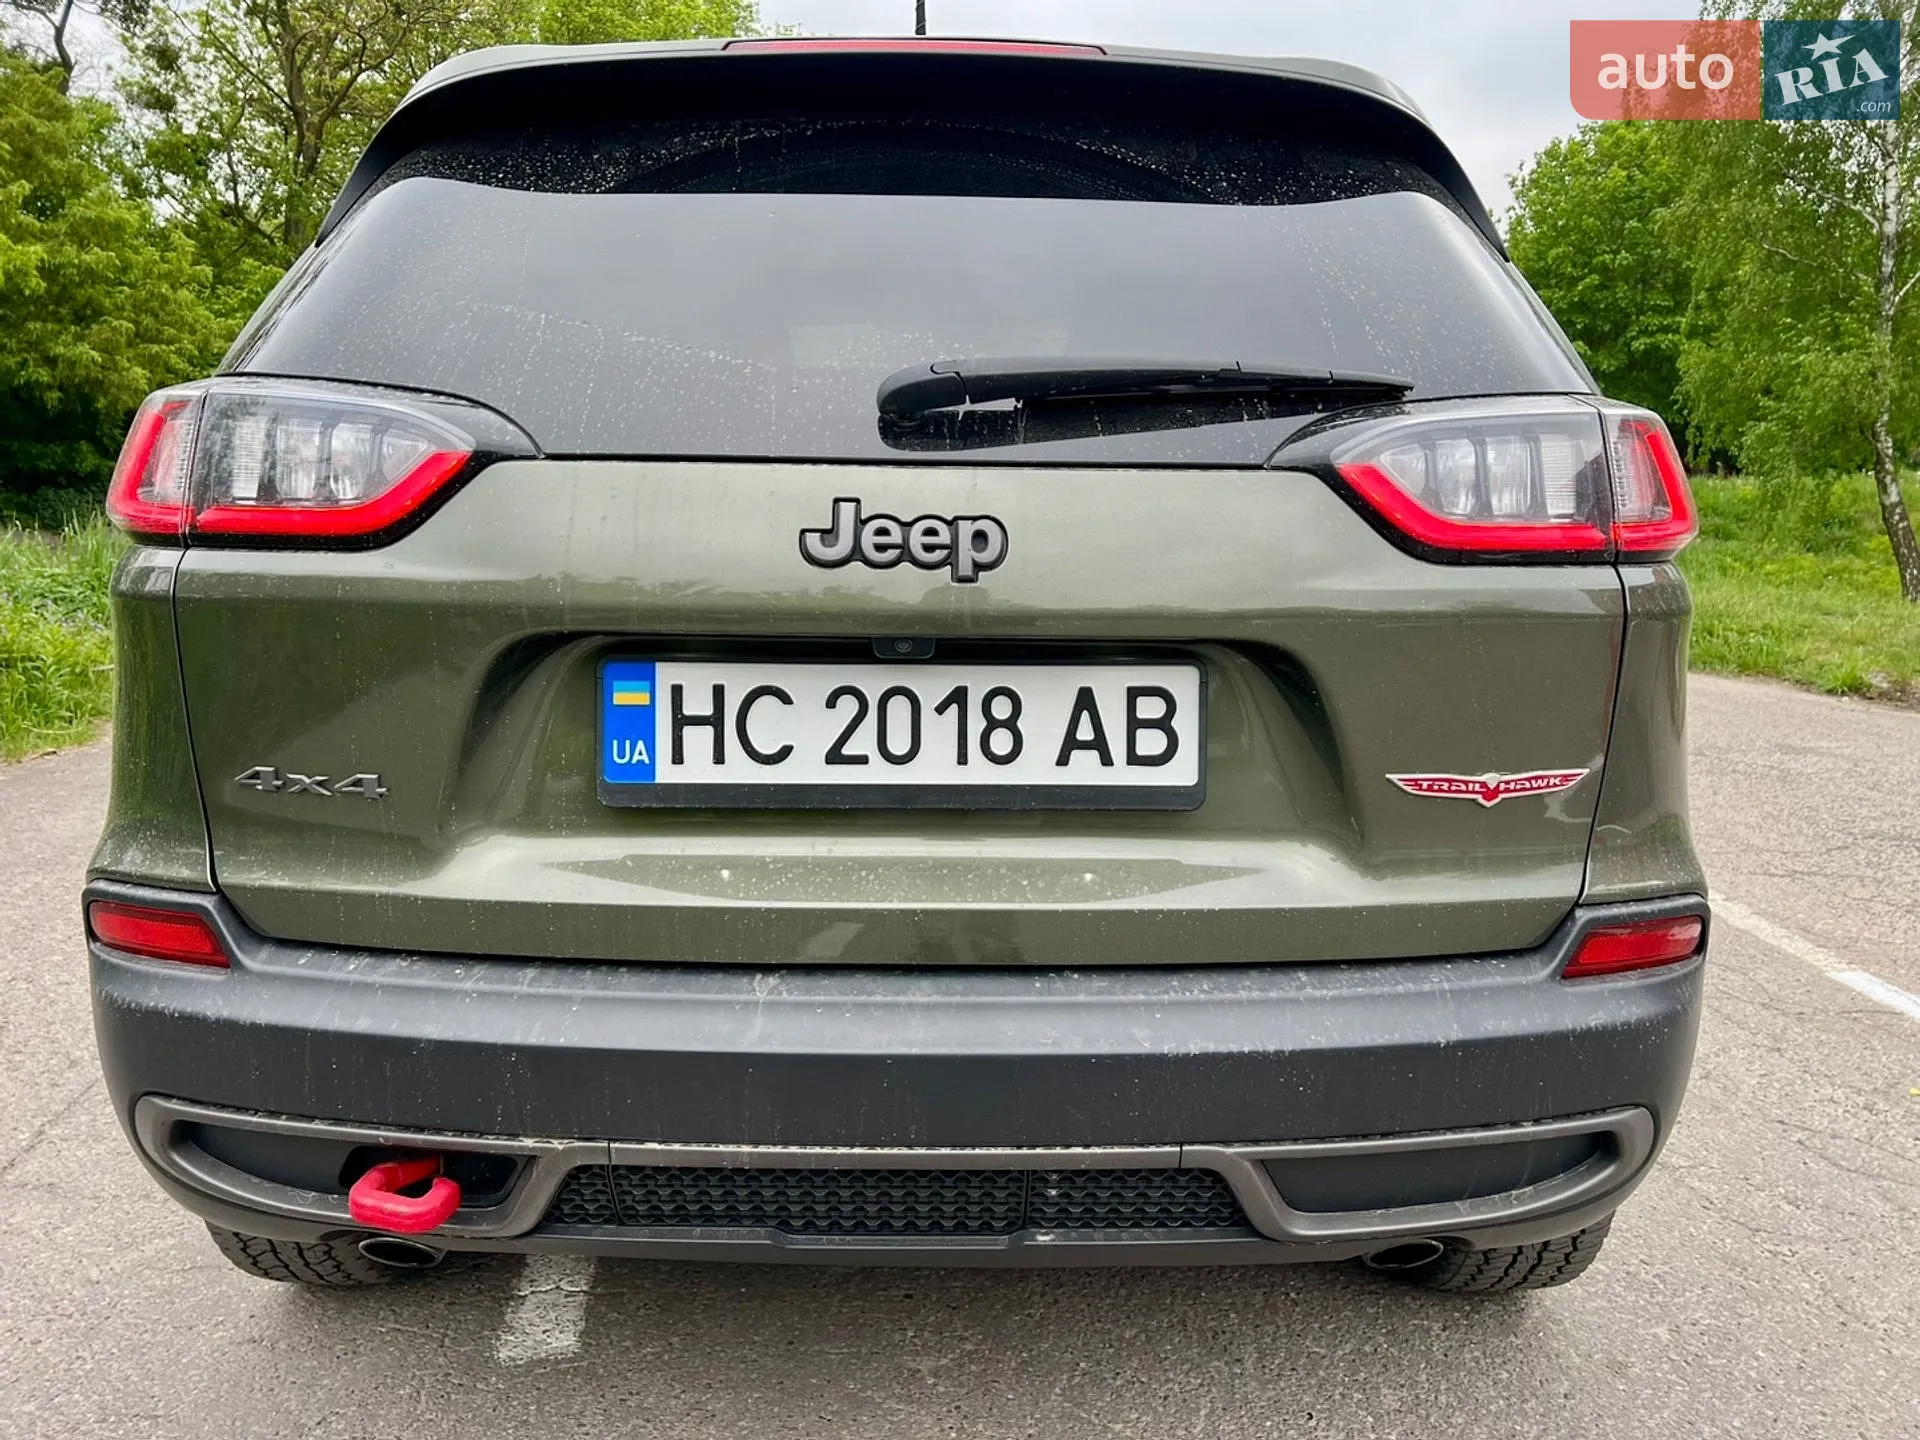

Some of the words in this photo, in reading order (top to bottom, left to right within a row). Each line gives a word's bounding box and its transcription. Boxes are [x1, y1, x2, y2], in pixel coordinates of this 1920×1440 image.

[799, 497, 1009, 583] Jeep
[612, 739, 650, 764] UA
[671, 683, 794, 765] HC
[824, 685, 1024, 766] 2018
[1055, 686, 1179, 767] AB
